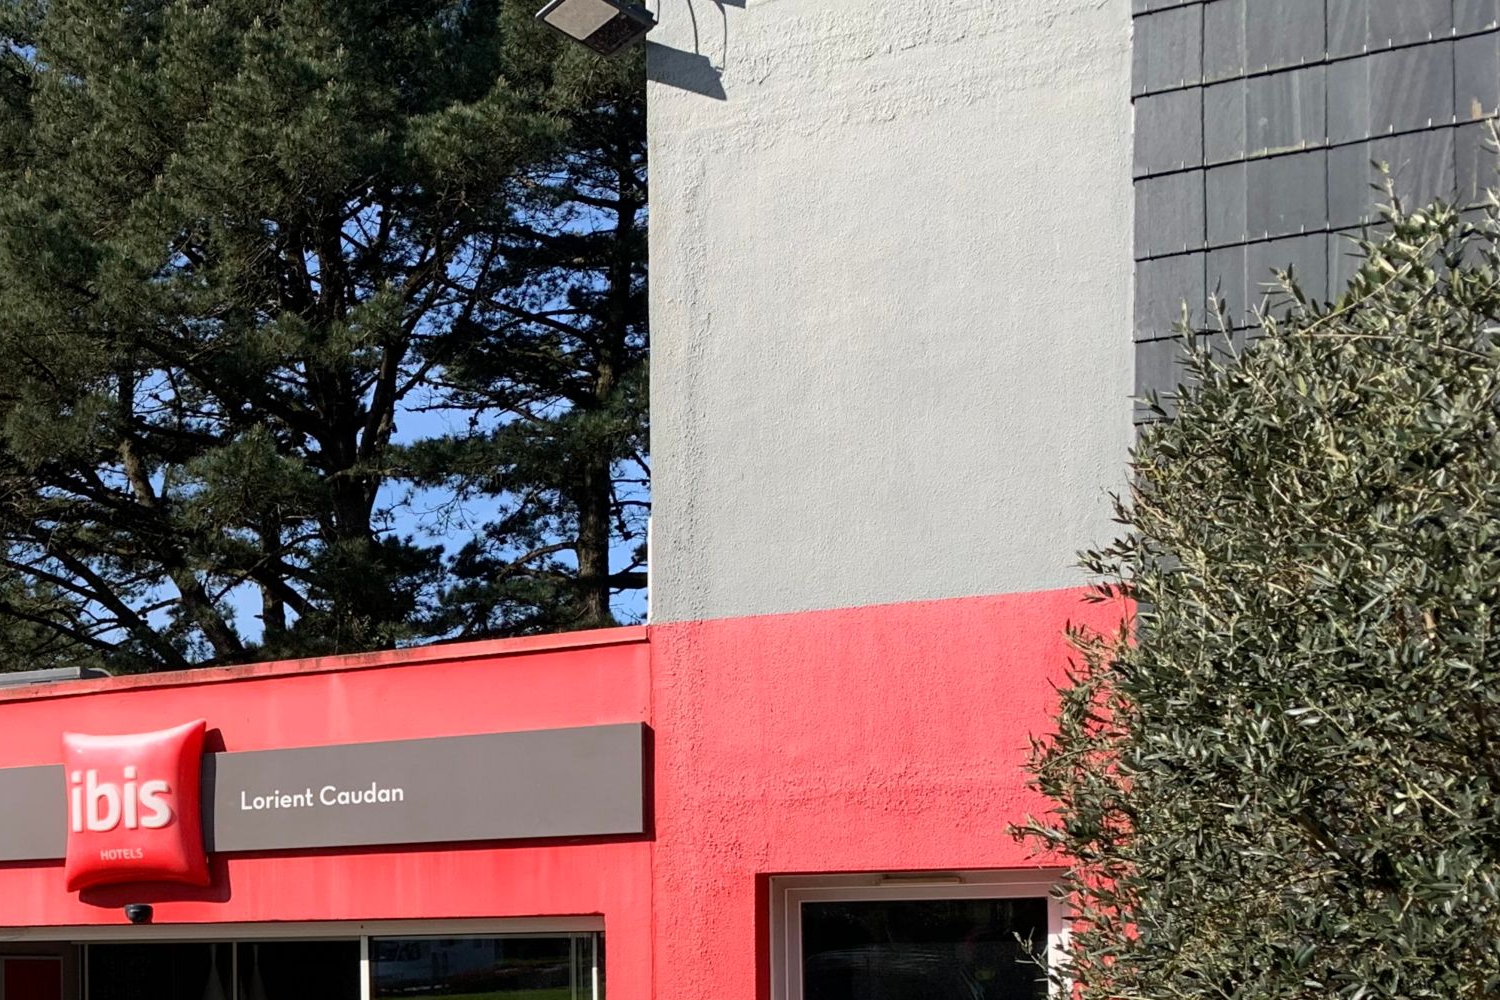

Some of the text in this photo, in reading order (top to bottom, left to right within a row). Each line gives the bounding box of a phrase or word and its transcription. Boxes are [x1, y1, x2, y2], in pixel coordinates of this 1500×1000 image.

[70, 765, 172, 833] ibis
[241, 781, 404, 810] Lorient Caudan
[99, 848, 144, 861] HOTELS
